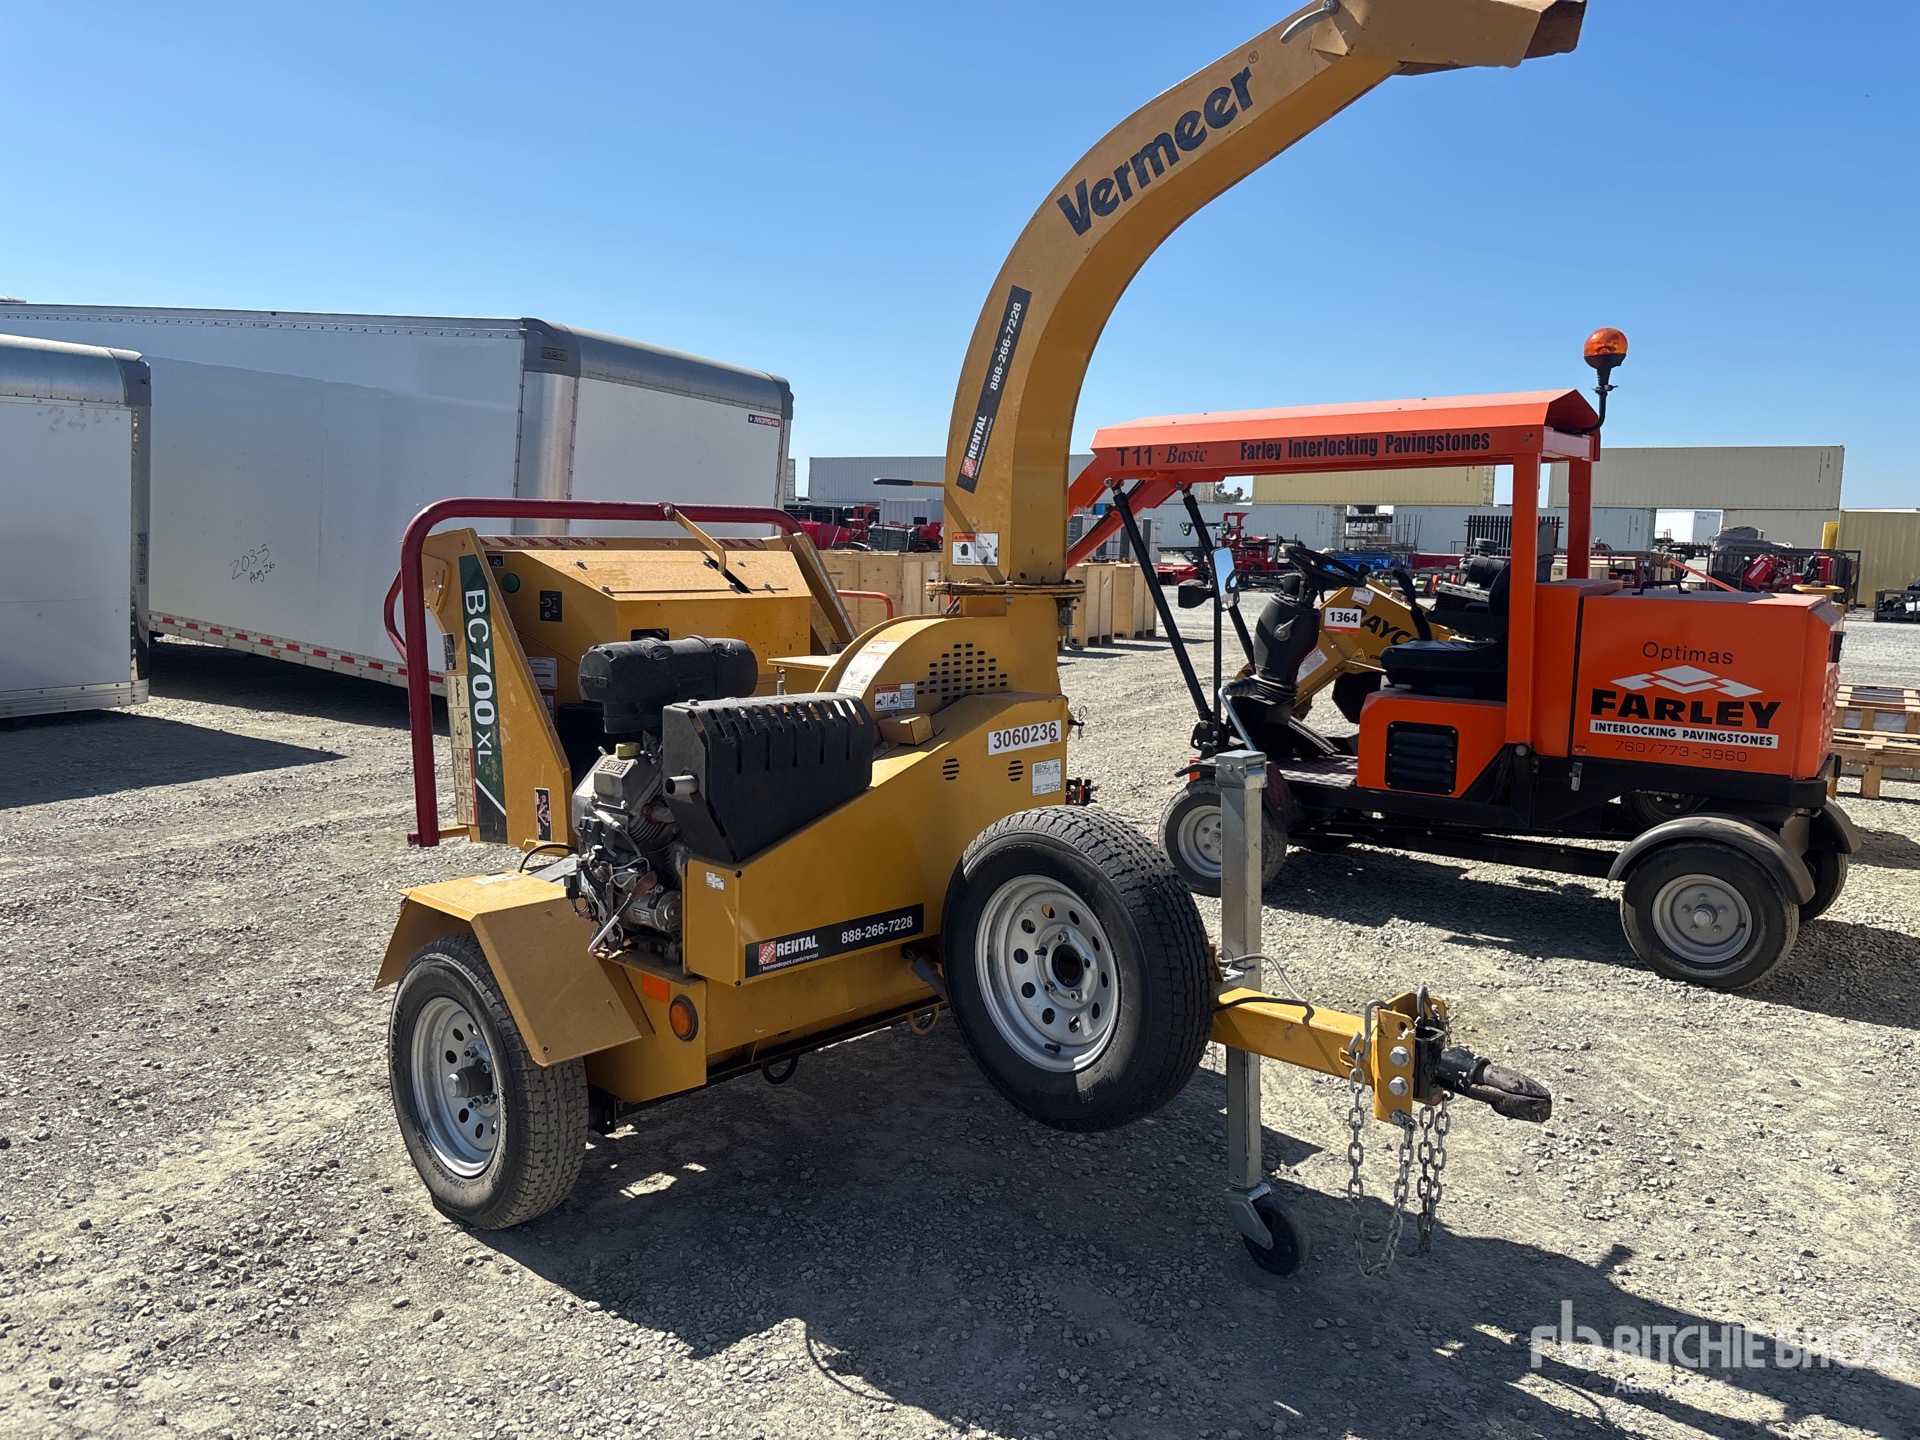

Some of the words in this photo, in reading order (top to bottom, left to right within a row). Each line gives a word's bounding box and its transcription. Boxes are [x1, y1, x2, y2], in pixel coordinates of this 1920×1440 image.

[1056, 65, 1254, 237] Vermeer
[967, 415, 987, 460] RENTAL
[989, 302, 1022, 391] 888-266-7228
[753, 416, 779, 427] MORGAN
[1165, 444, 1208, 465] Basic
[1240, 441, 1282, 461] Farley
[1288, 435, 1379, 459] Interlocking
[1385, 432, 1490, 454] Pavingstones
[1329, 611, 1358, 623] 1364
[1642, 641, 1734, 665] Optimas
[1590, 688, 1781, 729] FARLEY
[476, 731, 493, 766] XL
[993, 721, 1057, 750] 3060236
[1594, 721, 1677, 739] INTERLOCKING
[1682, 729, 1773, 747] PAVINGSTONES
[1615, 740, 1748, 763] 760/773-3960
[776, 934, 819, 957] RENTAL
[841, 915, 913, 944] 888-266-7228
